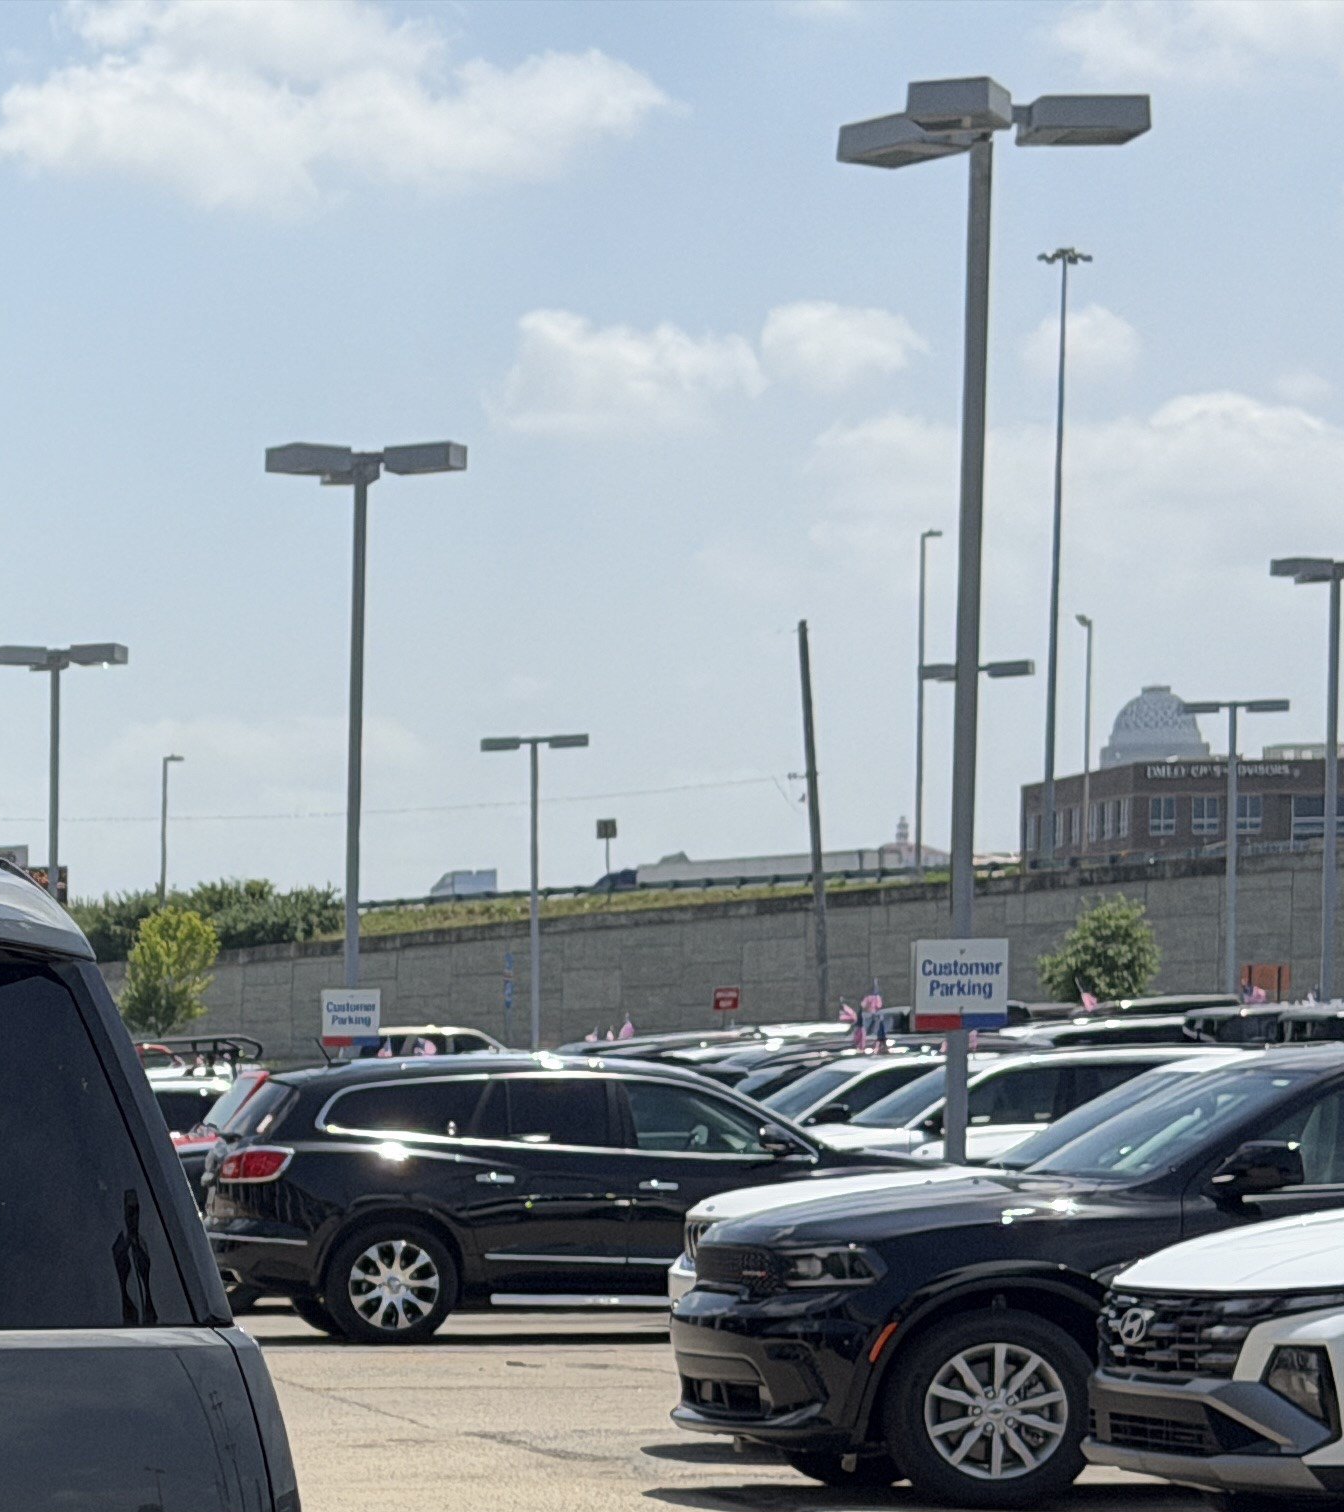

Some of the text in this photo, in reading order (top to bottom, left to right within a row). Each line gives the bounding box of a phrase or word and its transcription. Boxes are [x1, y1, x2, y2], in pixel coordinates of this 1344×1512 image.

[921, 959, 1003, 977] Customer
[929, 979, 993, 999] Parking
[326, 1001, 376, 1013] Customer
[331, 1014, 372, 1028] Parking
